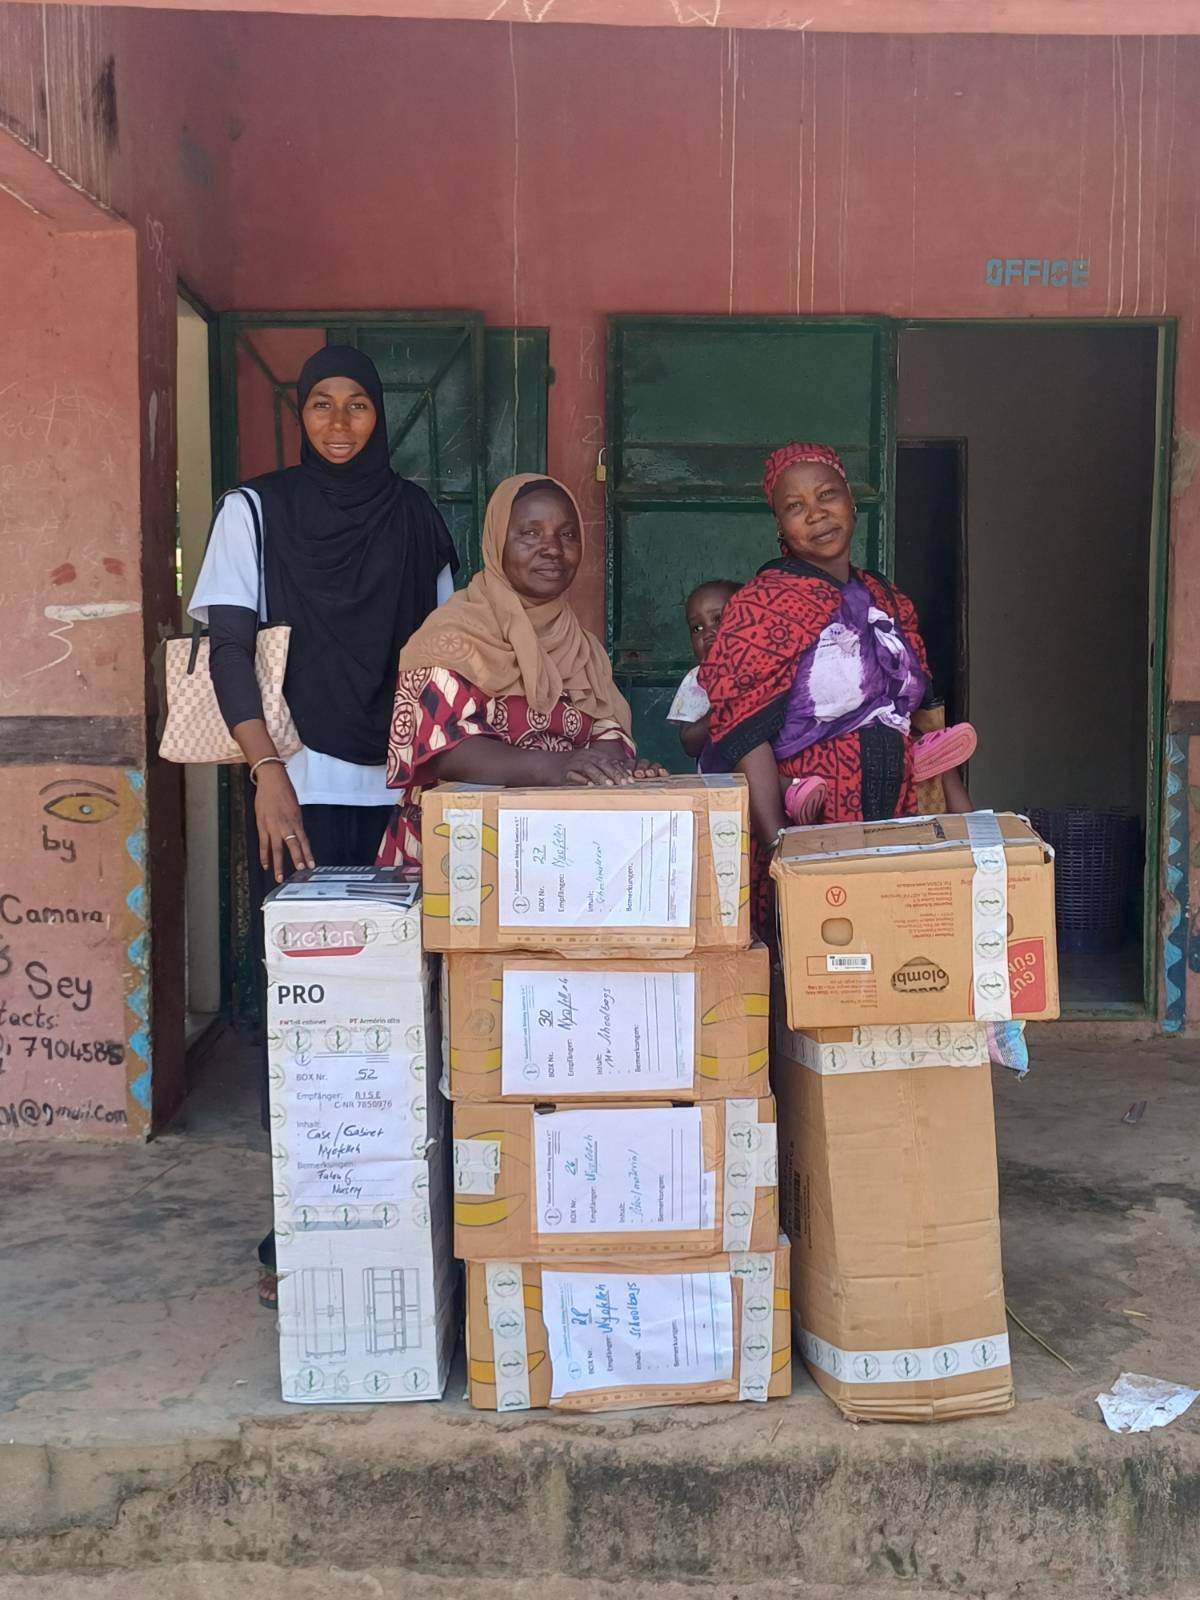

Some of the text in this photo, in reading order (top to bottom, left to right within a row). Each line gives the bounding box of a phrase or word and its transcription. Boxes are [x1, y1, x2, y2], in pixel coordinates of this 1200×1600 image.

[985, 257, 1089, 288] OFFICE
[43, 824, 77, 863] by
[0, 894, 104, 926] Camara
[25, 961, 92, 1011] Sey
[278, 983, 325, 1005] PRO
[538, 1009, 552, 1028] 30
[296, 1073, 314, 1081] BOX
[358, 1068, 377, 1080] 52
